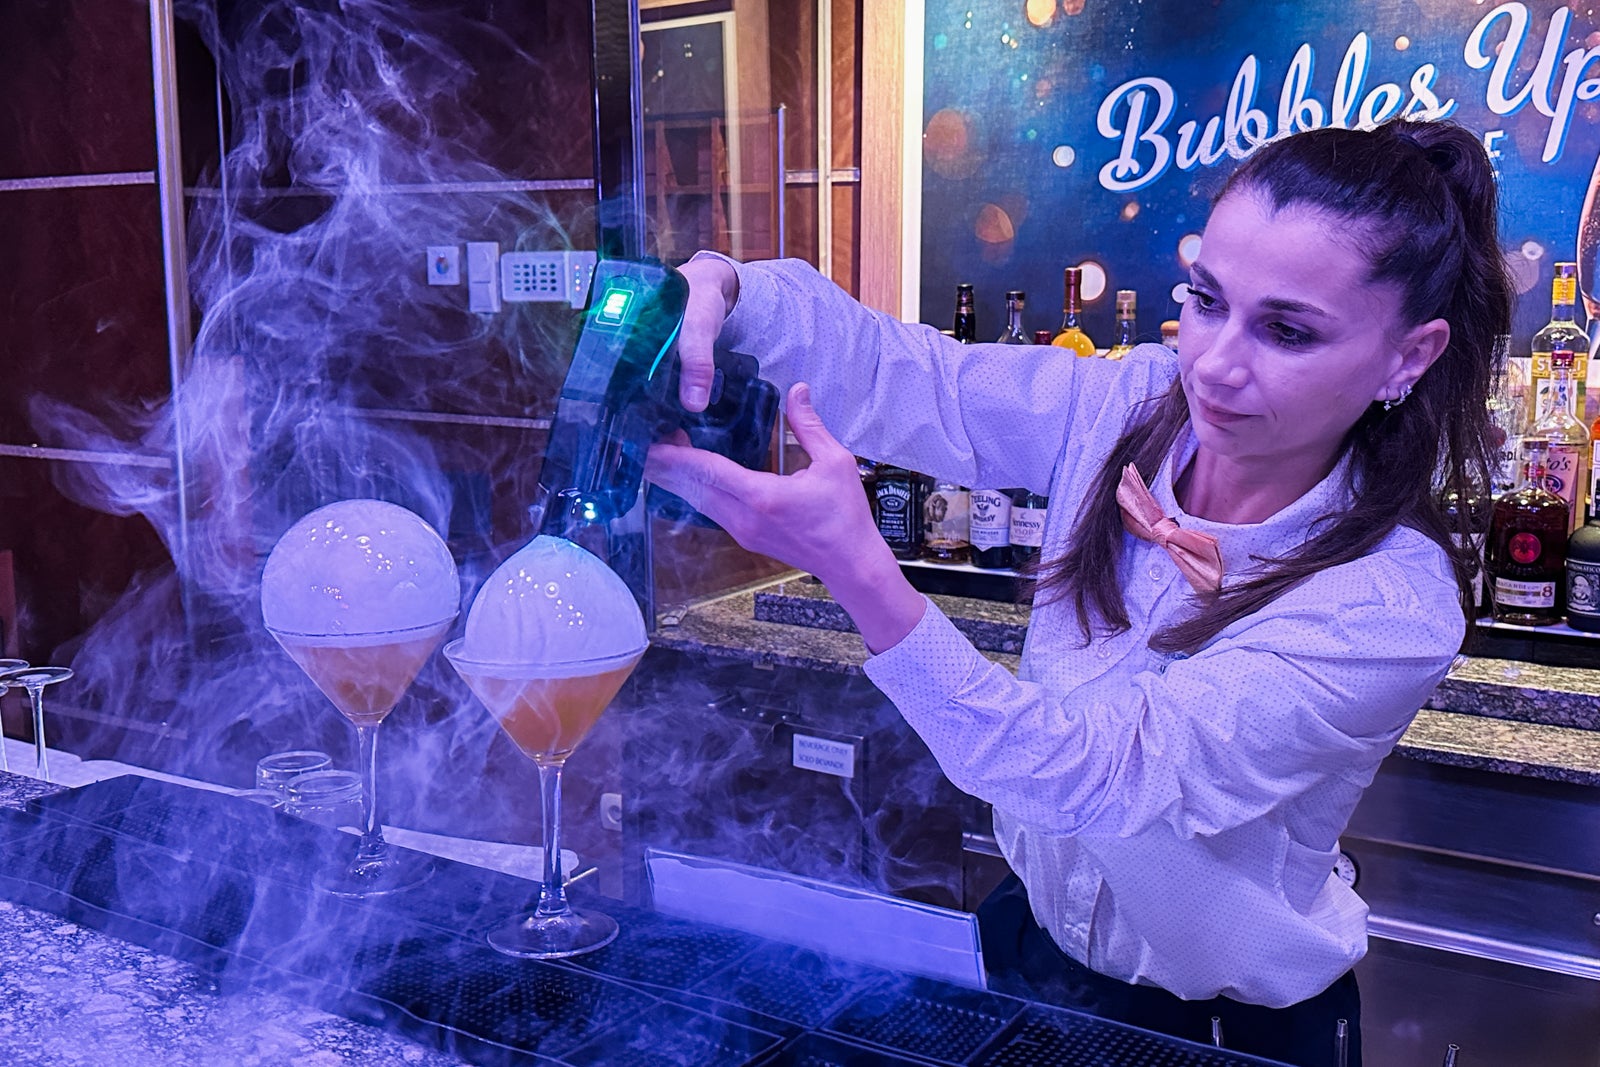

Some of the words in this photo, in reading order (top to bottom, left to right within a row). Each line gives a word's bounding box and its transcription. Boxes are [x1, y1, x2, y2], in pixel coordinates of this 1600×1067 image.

[1097, 31, 1458, 193] Bubbles
[1463, 2, 1600, 165] Up
[1537, 358, 1581, 371] STI
[971, 495, 1001, 507] TEELING
[1542, 586, 1553, 598] 8
[799, 740, 830, 753] BEVERAGE
[815, 757, 845, 769] BEVANDE
